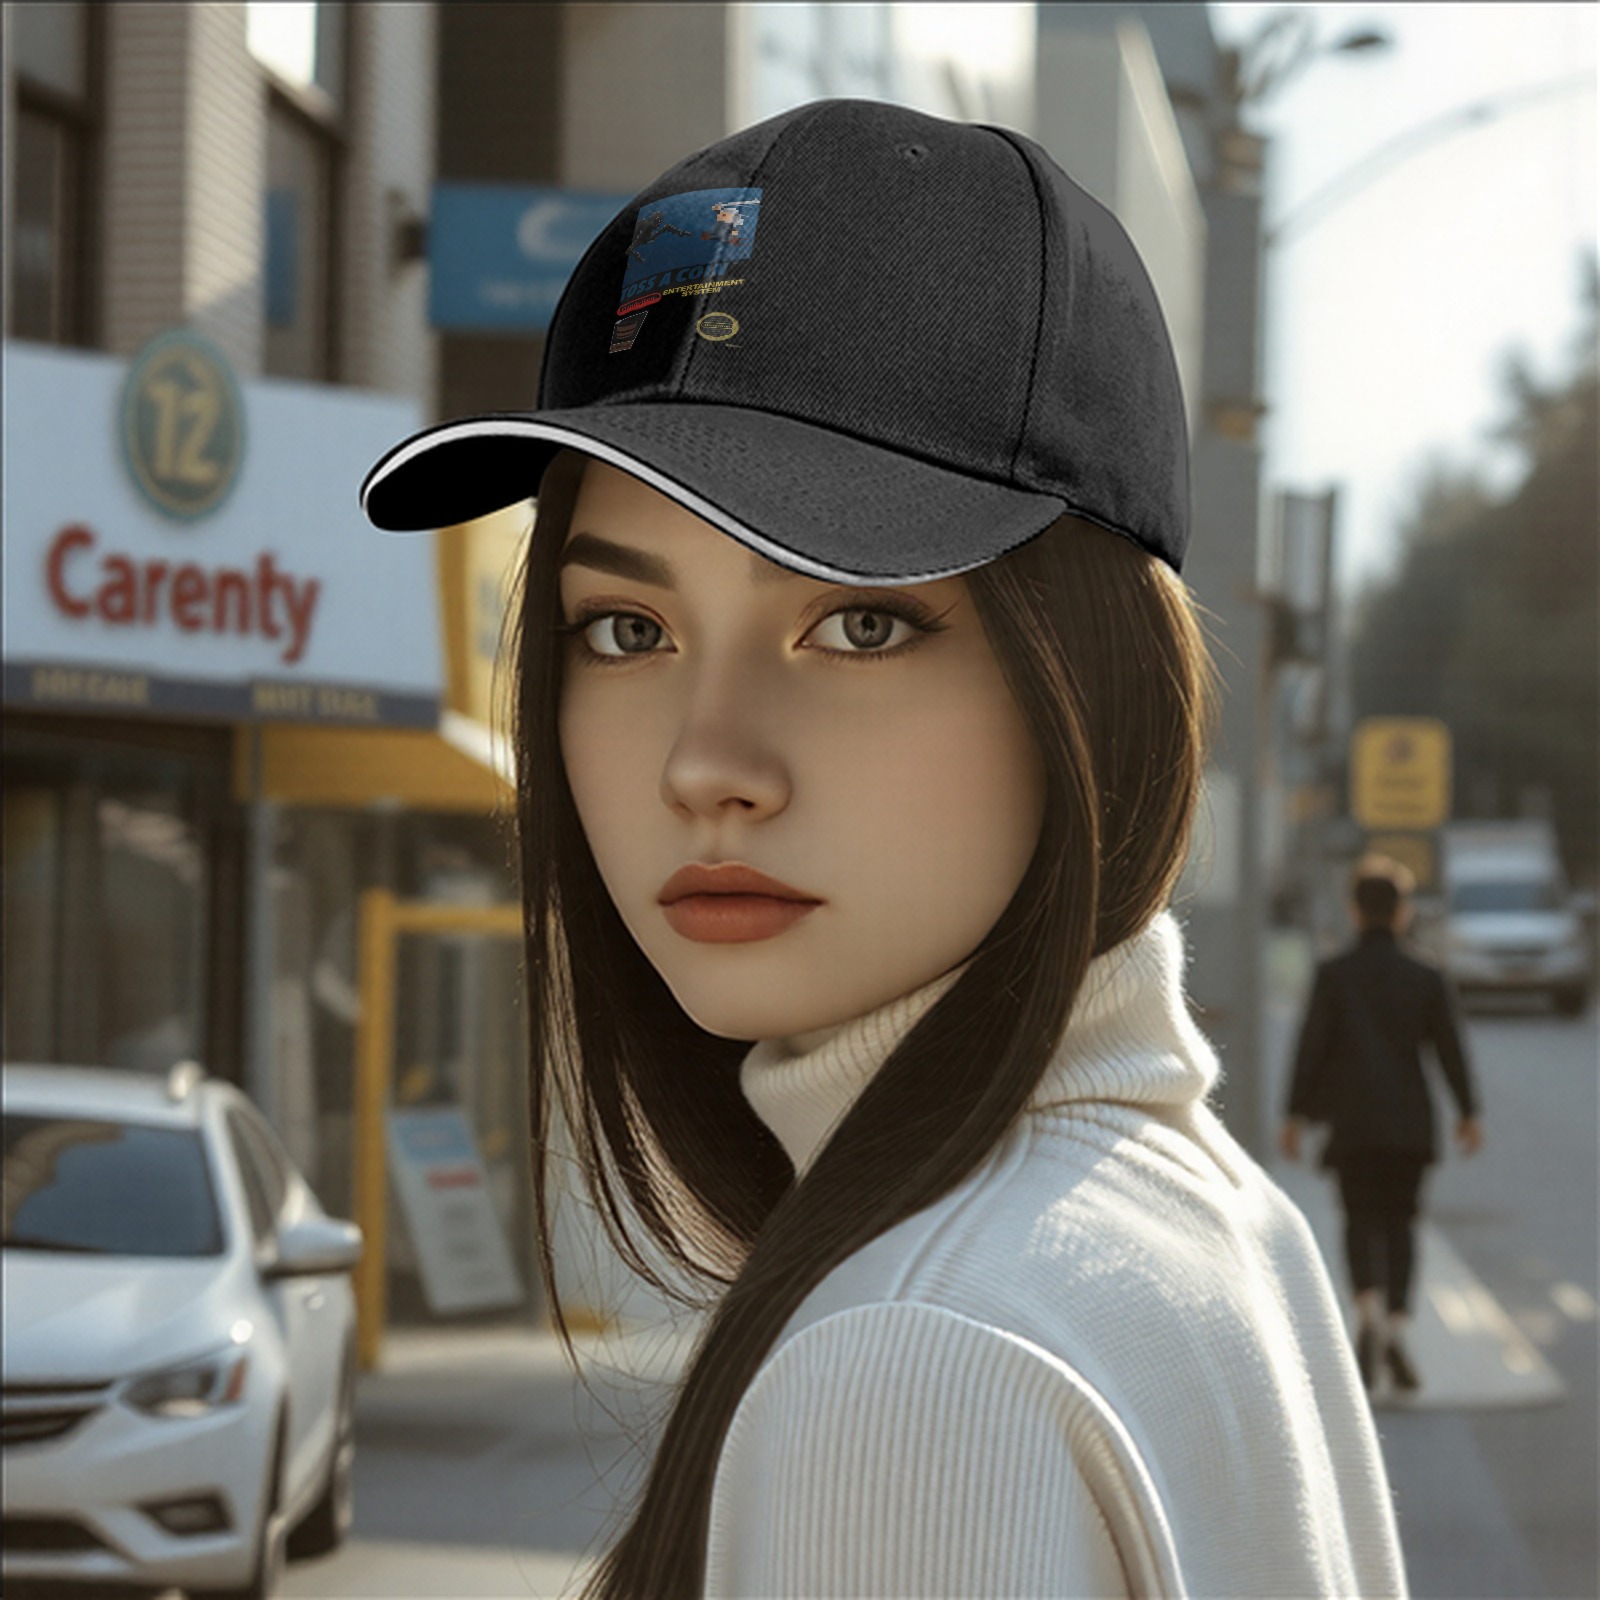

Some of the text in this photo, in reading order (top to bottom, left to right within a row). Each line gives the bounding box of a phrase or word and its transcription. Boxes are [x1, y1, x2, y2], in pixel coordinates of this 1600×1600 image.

[620, 275, 657, 302] TOSS
[658, 271, 672, 288] A
[662, 279, 745, 296] ENTERTAINMENT
[681, 287, 722, 297] SYSTEM
[46, 523, 321, 666] Carenty
